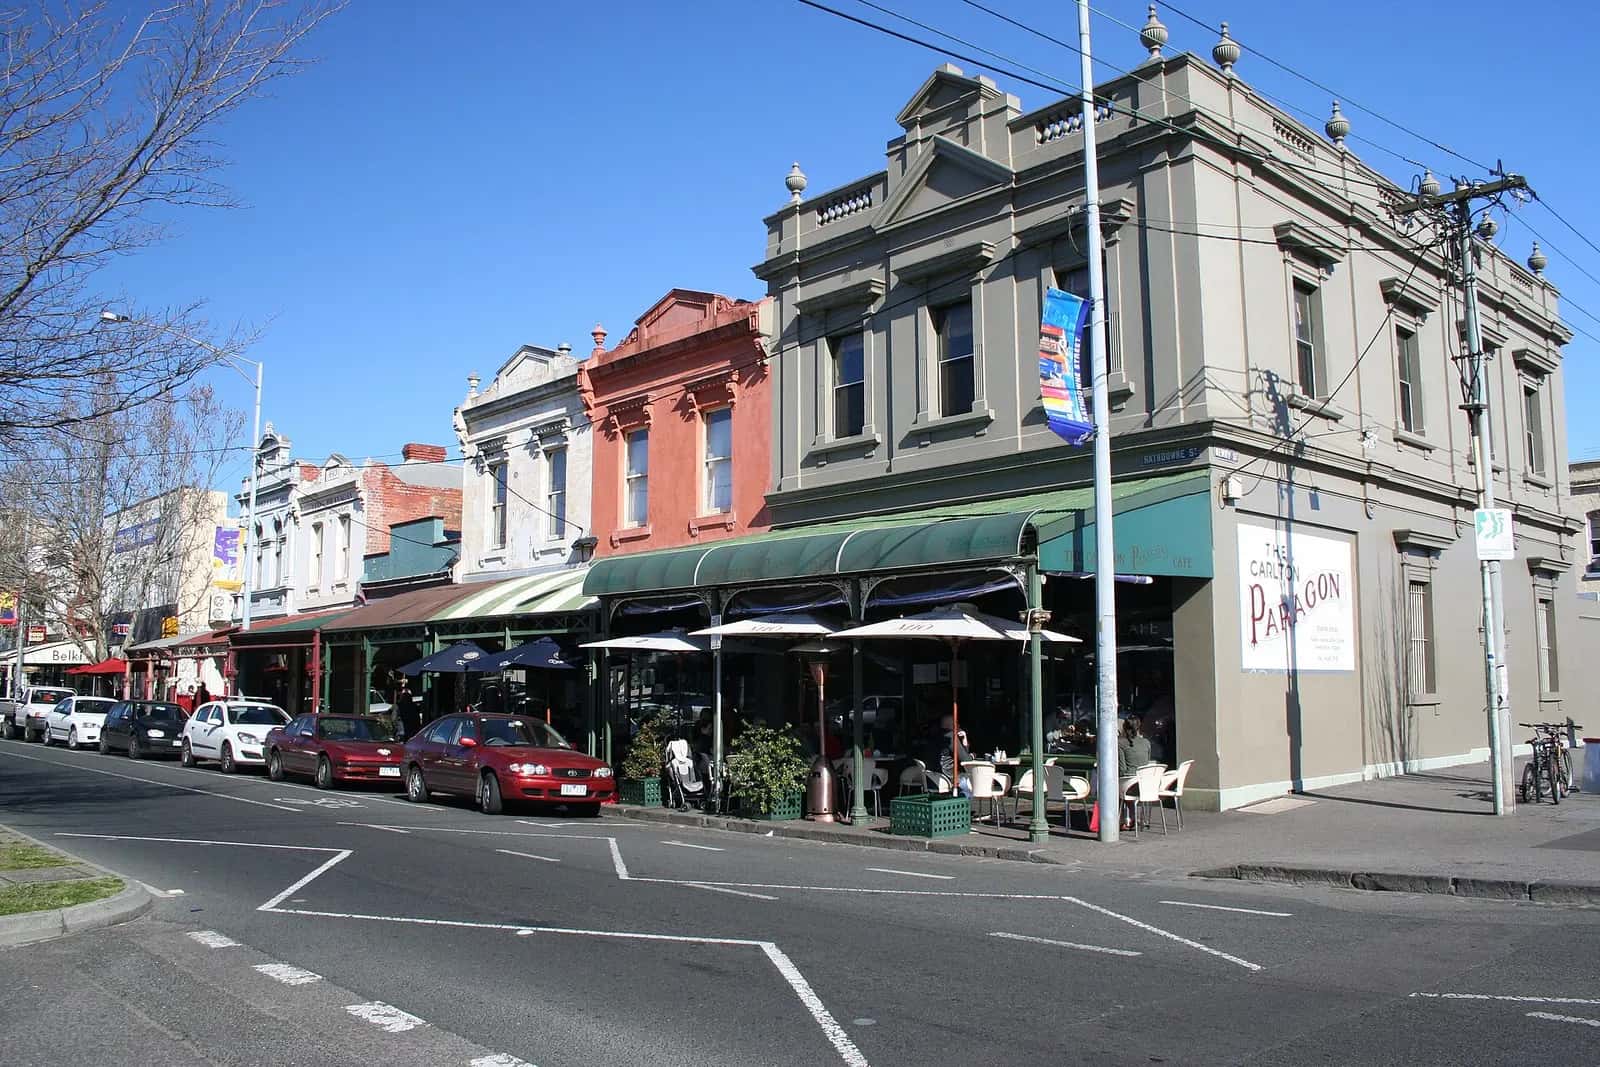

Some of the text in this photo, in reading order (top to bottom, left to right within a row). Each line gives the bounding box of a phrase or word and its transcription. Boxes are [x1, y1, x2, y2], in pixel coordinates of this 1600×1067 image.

[1265, 543, 1287, 559] THE
[1250, 560, 1300, 583] CARLTON
[1248, 572, 1340, 648] PARAGON
